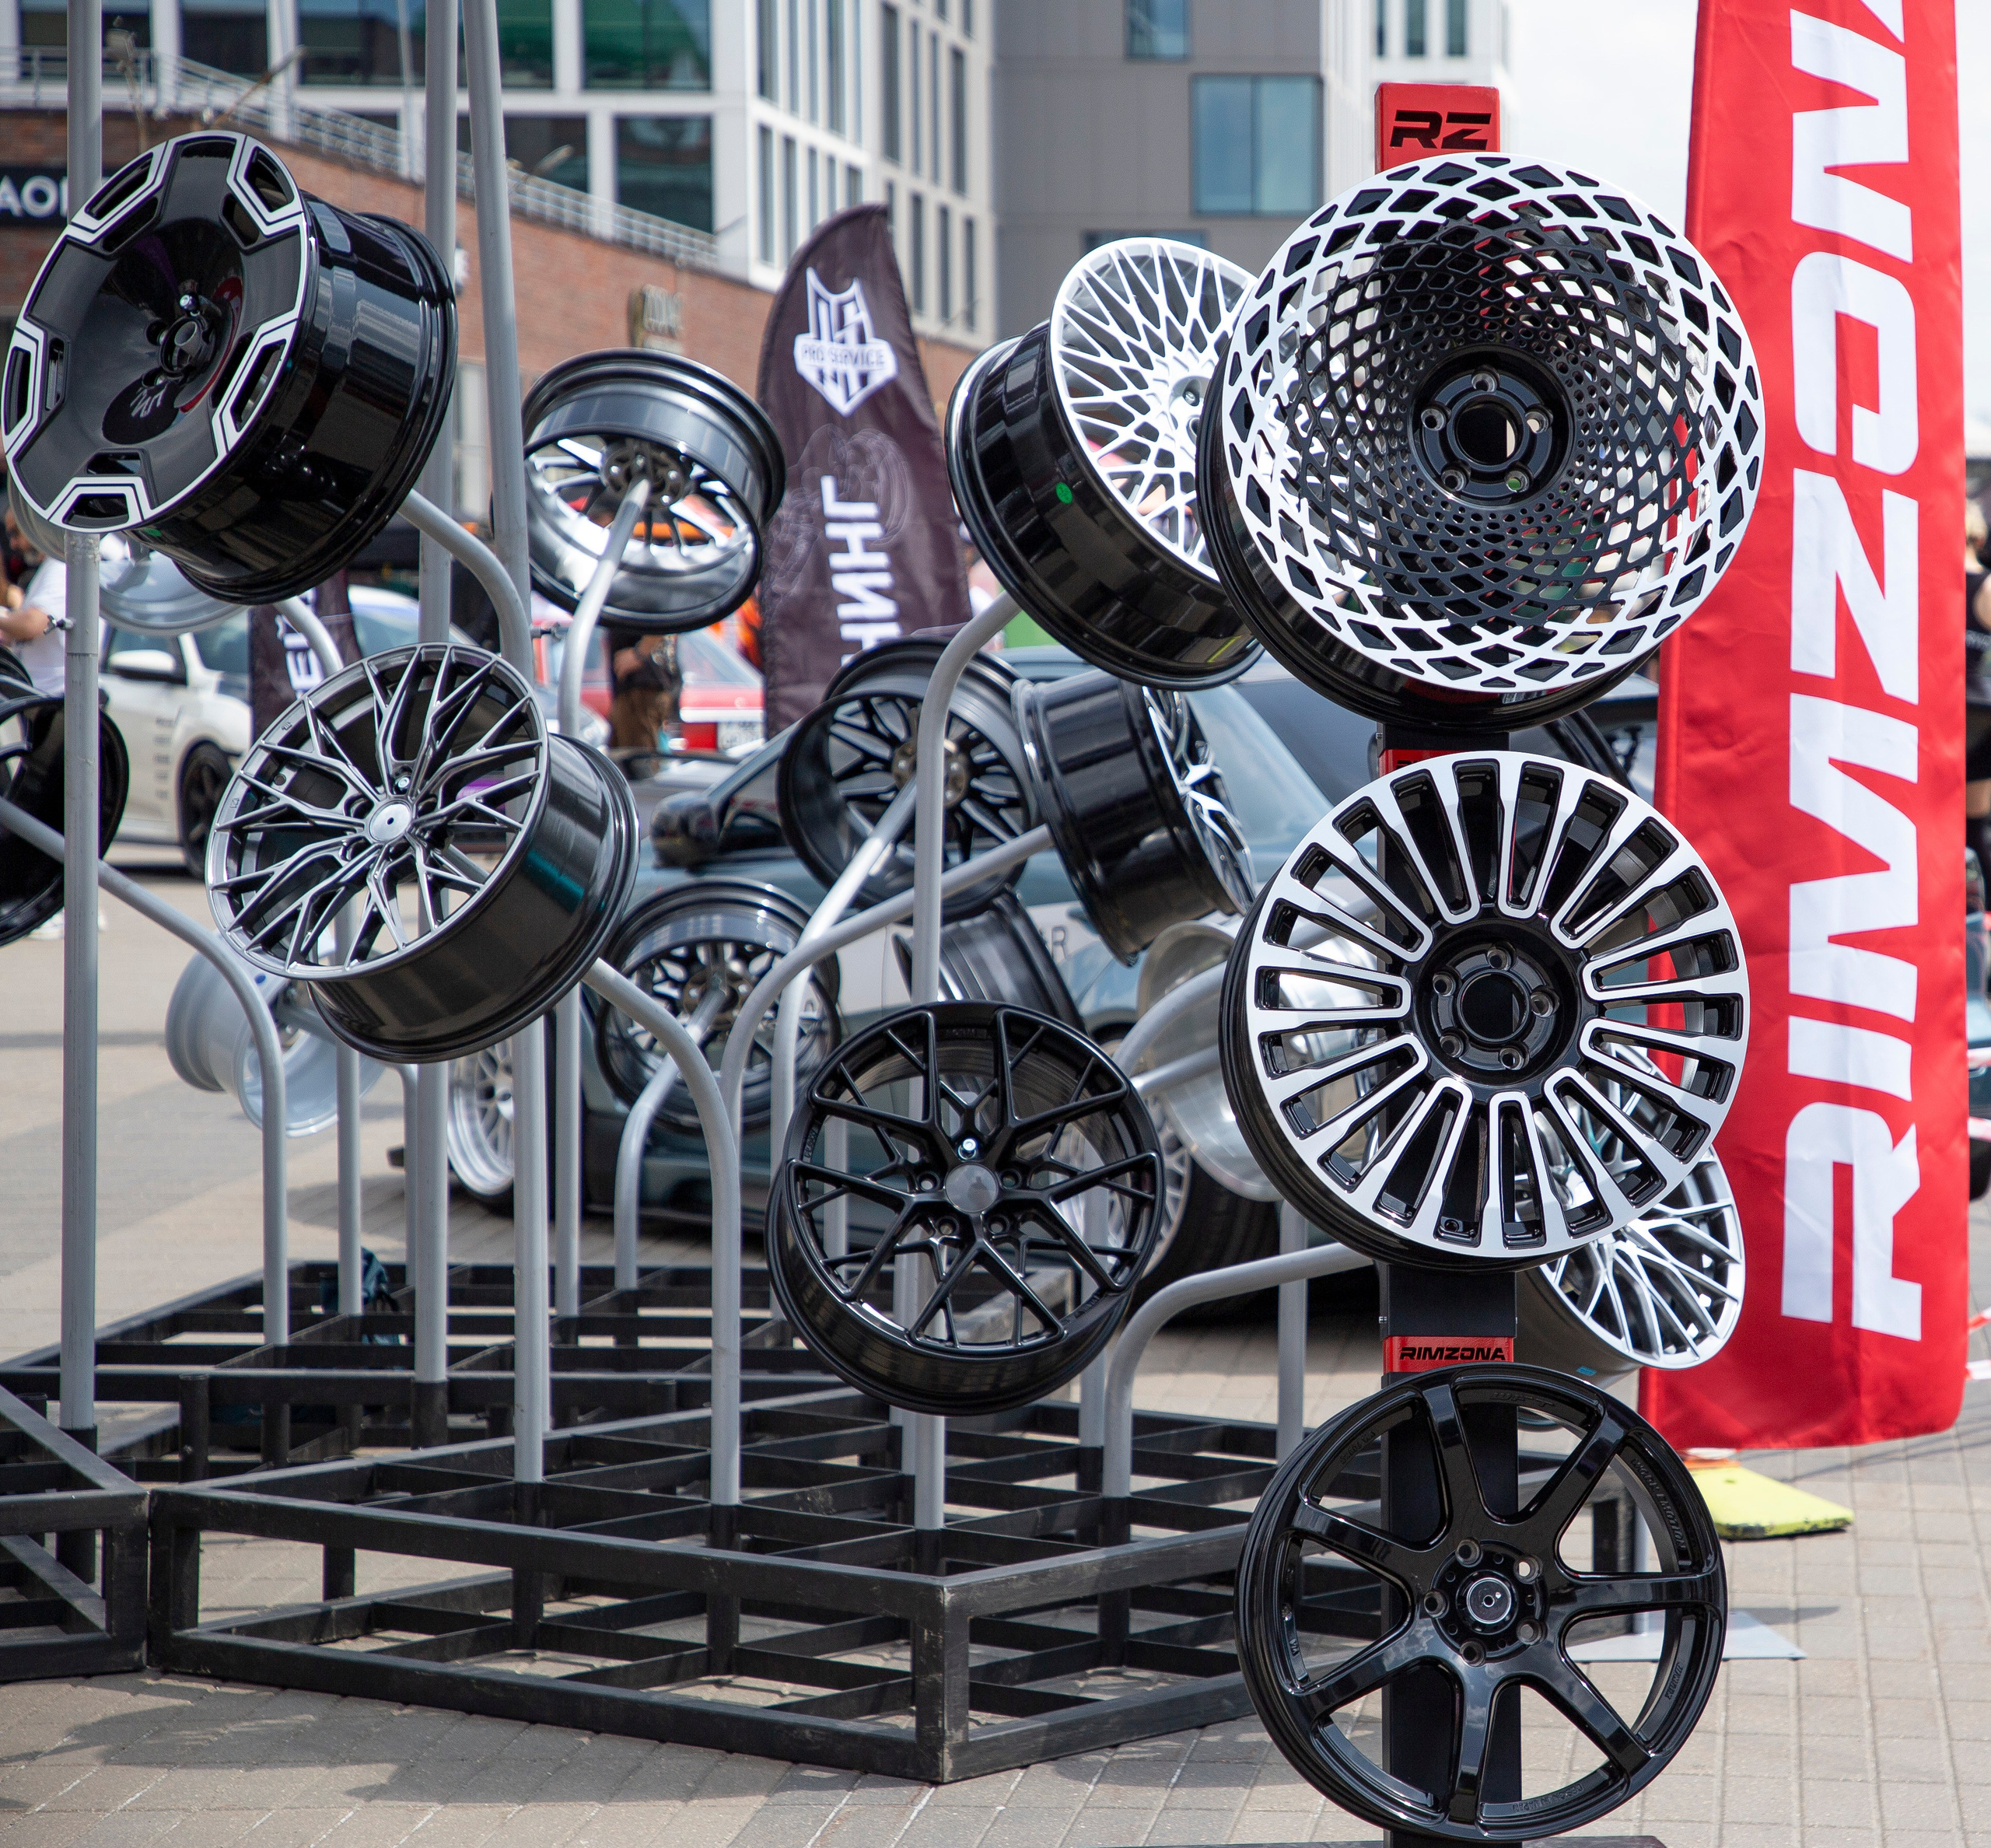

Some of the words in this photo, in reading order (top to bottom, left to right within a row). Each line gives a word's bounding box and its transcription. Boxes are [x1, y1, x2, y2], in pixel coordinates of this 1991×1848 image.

[1390, 110, 1492, 150] RZ
[802, 344, 824, 362] PRO
[828, 346, 885, 367] SERVICE
[1781, 0, 1922, 1341] RIMZON
[1400, 1347, 1506, 1361] RIMZONA
